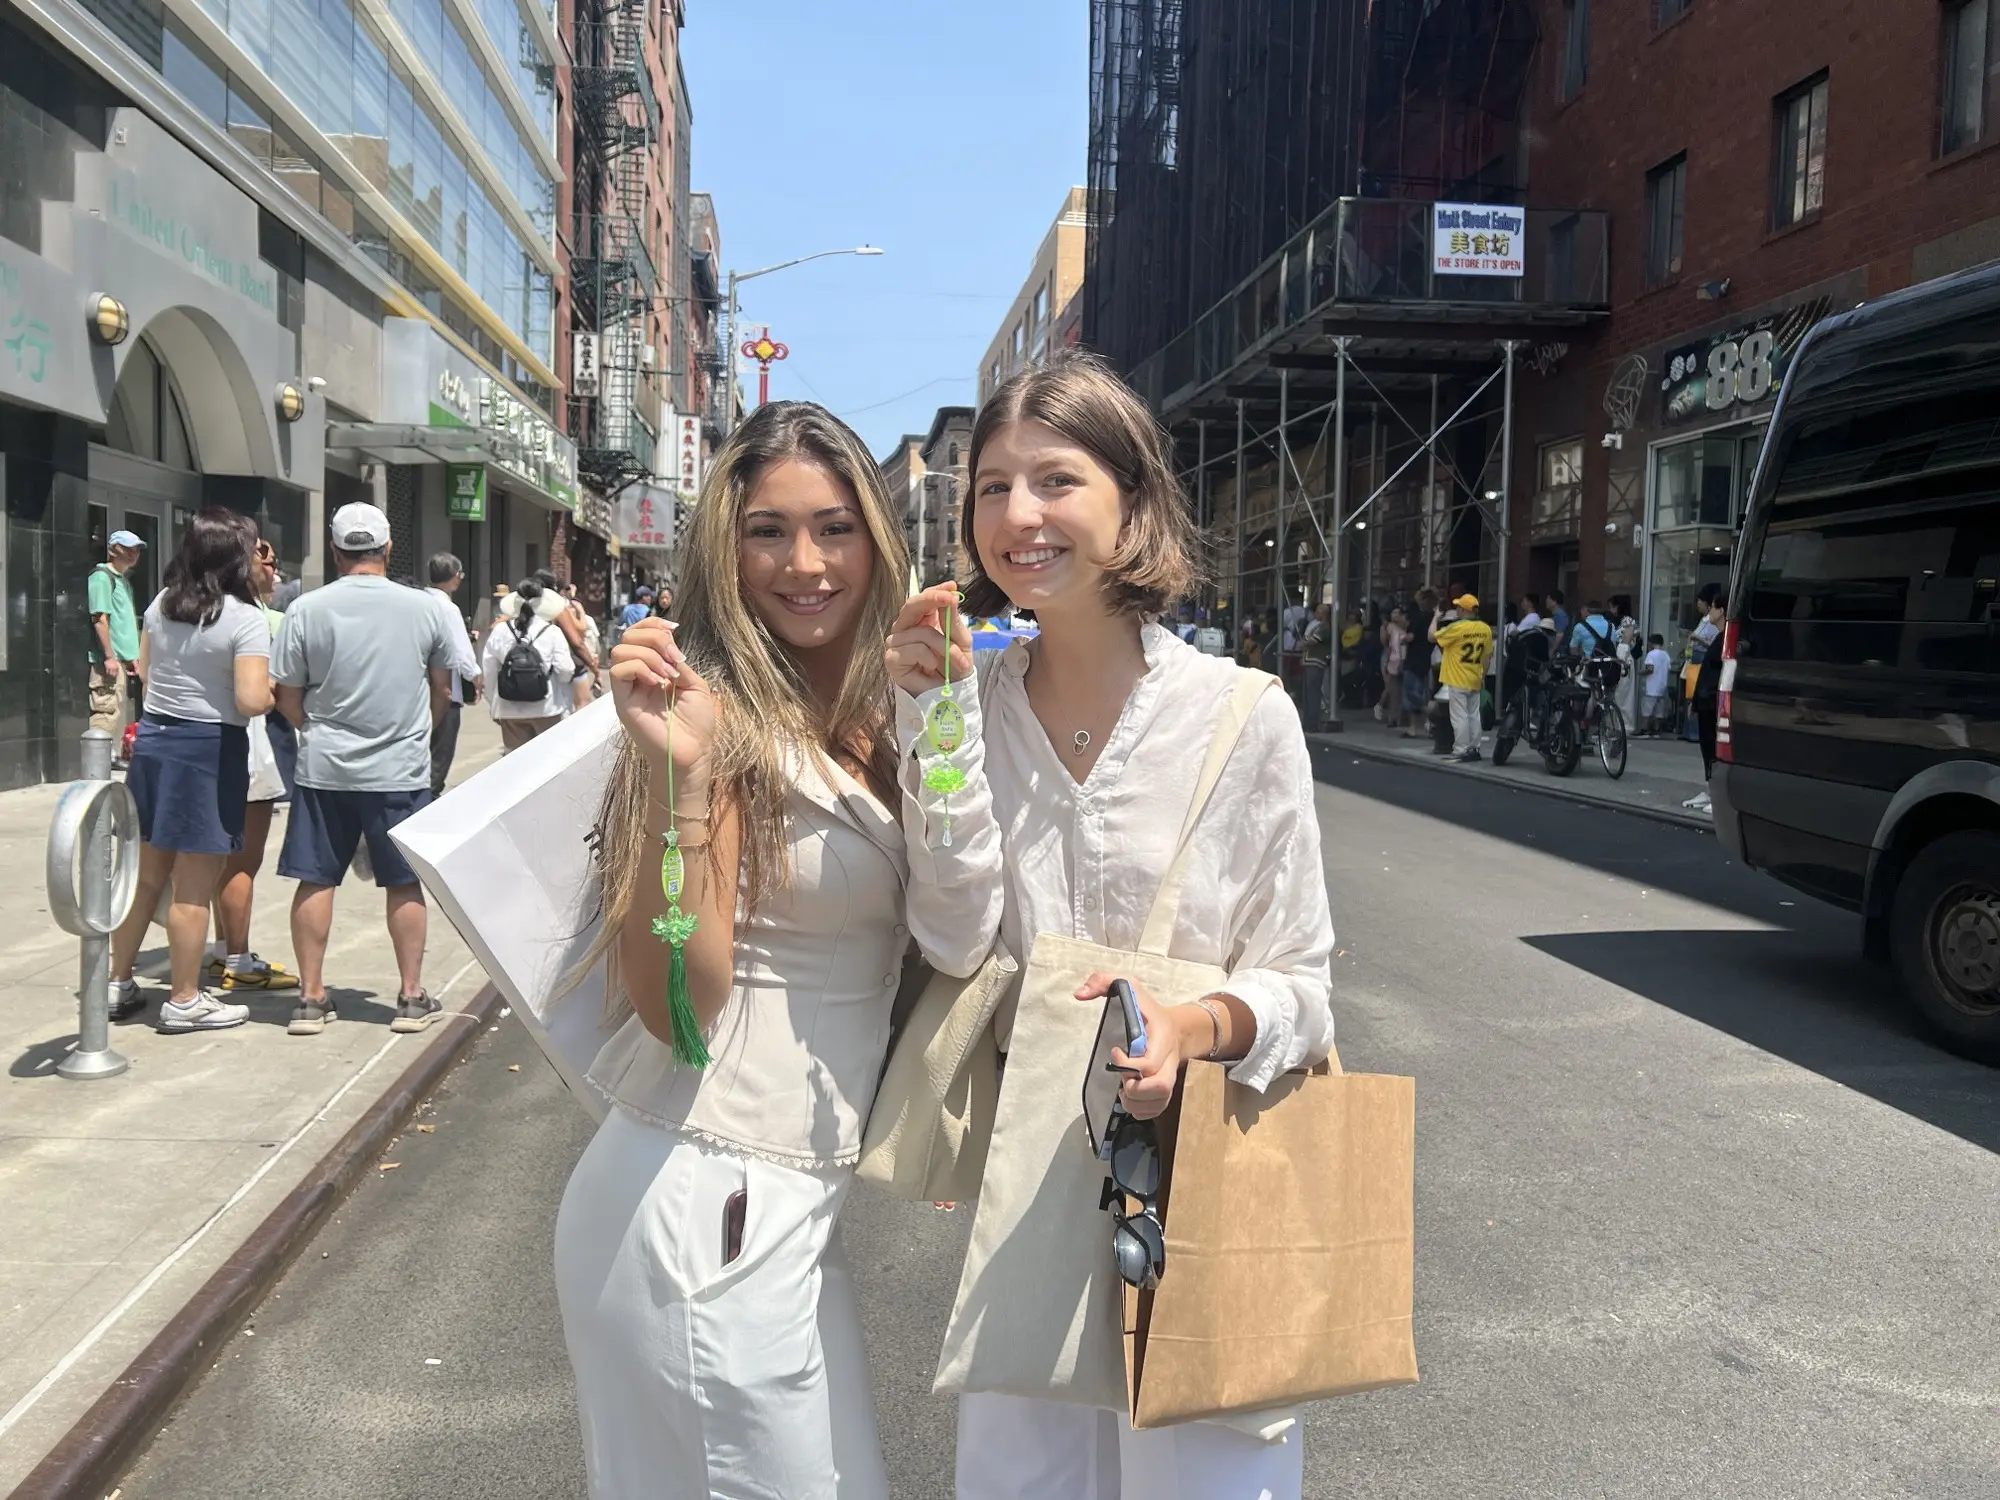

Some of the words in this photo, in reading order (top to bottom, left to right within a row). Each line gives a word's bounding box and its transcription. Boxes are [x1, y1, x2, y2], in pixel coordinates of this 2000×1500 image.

[110, 177, 175, 251] United
[181, 222, 235, 287] Orient
[1437, 209, 1460, 229] Mott
[1461, 210, 1490, 230] Street
[1491, 211, 1522, 236] Eatery
[1450, 231, 1510, 257] 美食坊
[1437, 257, 1452, 268] THE
[1454, 258, 1480, 269] STORE
[1482, 259, 1498, 270] IT'S
[1500, 260, 1521, 271] OPEN
[4, 308, 56, 384] 行
[1705, 330, 1774, 411] 88
[1460, 641, 1485, 664] 22
